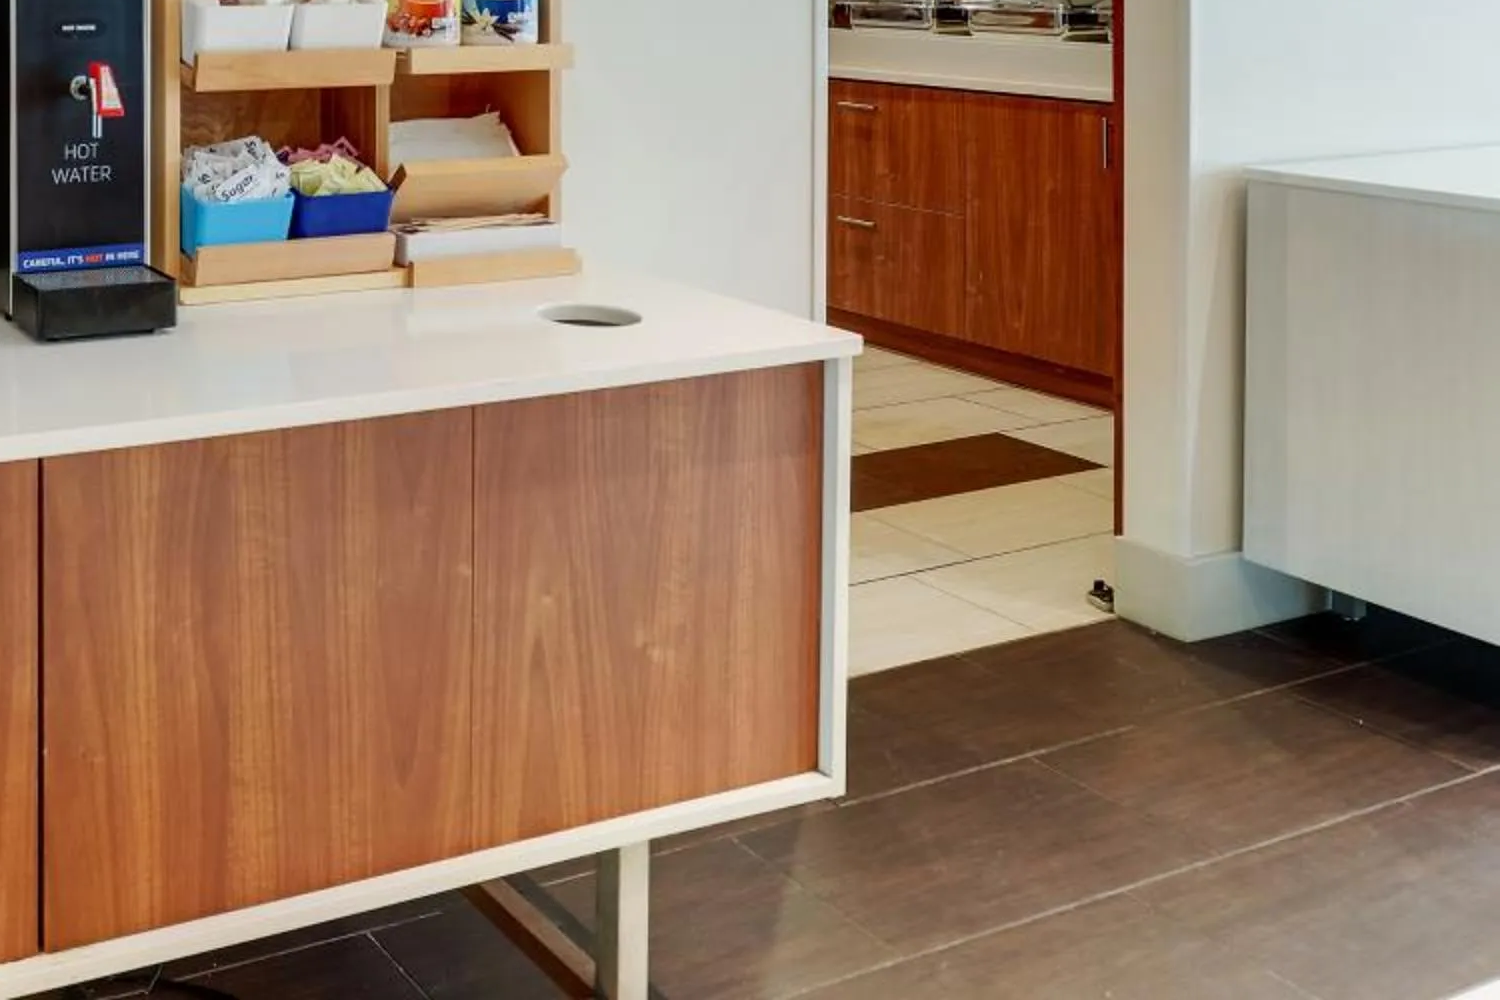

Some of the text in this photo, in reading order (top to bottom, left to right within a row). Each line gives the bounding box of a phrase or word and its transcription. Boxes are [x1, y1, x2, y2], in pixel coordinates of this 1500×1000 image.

[64, 142, 100, 160] HOT
[51, 165, 112, 185] WATER
[221, 174, 254, 201] Sugar
